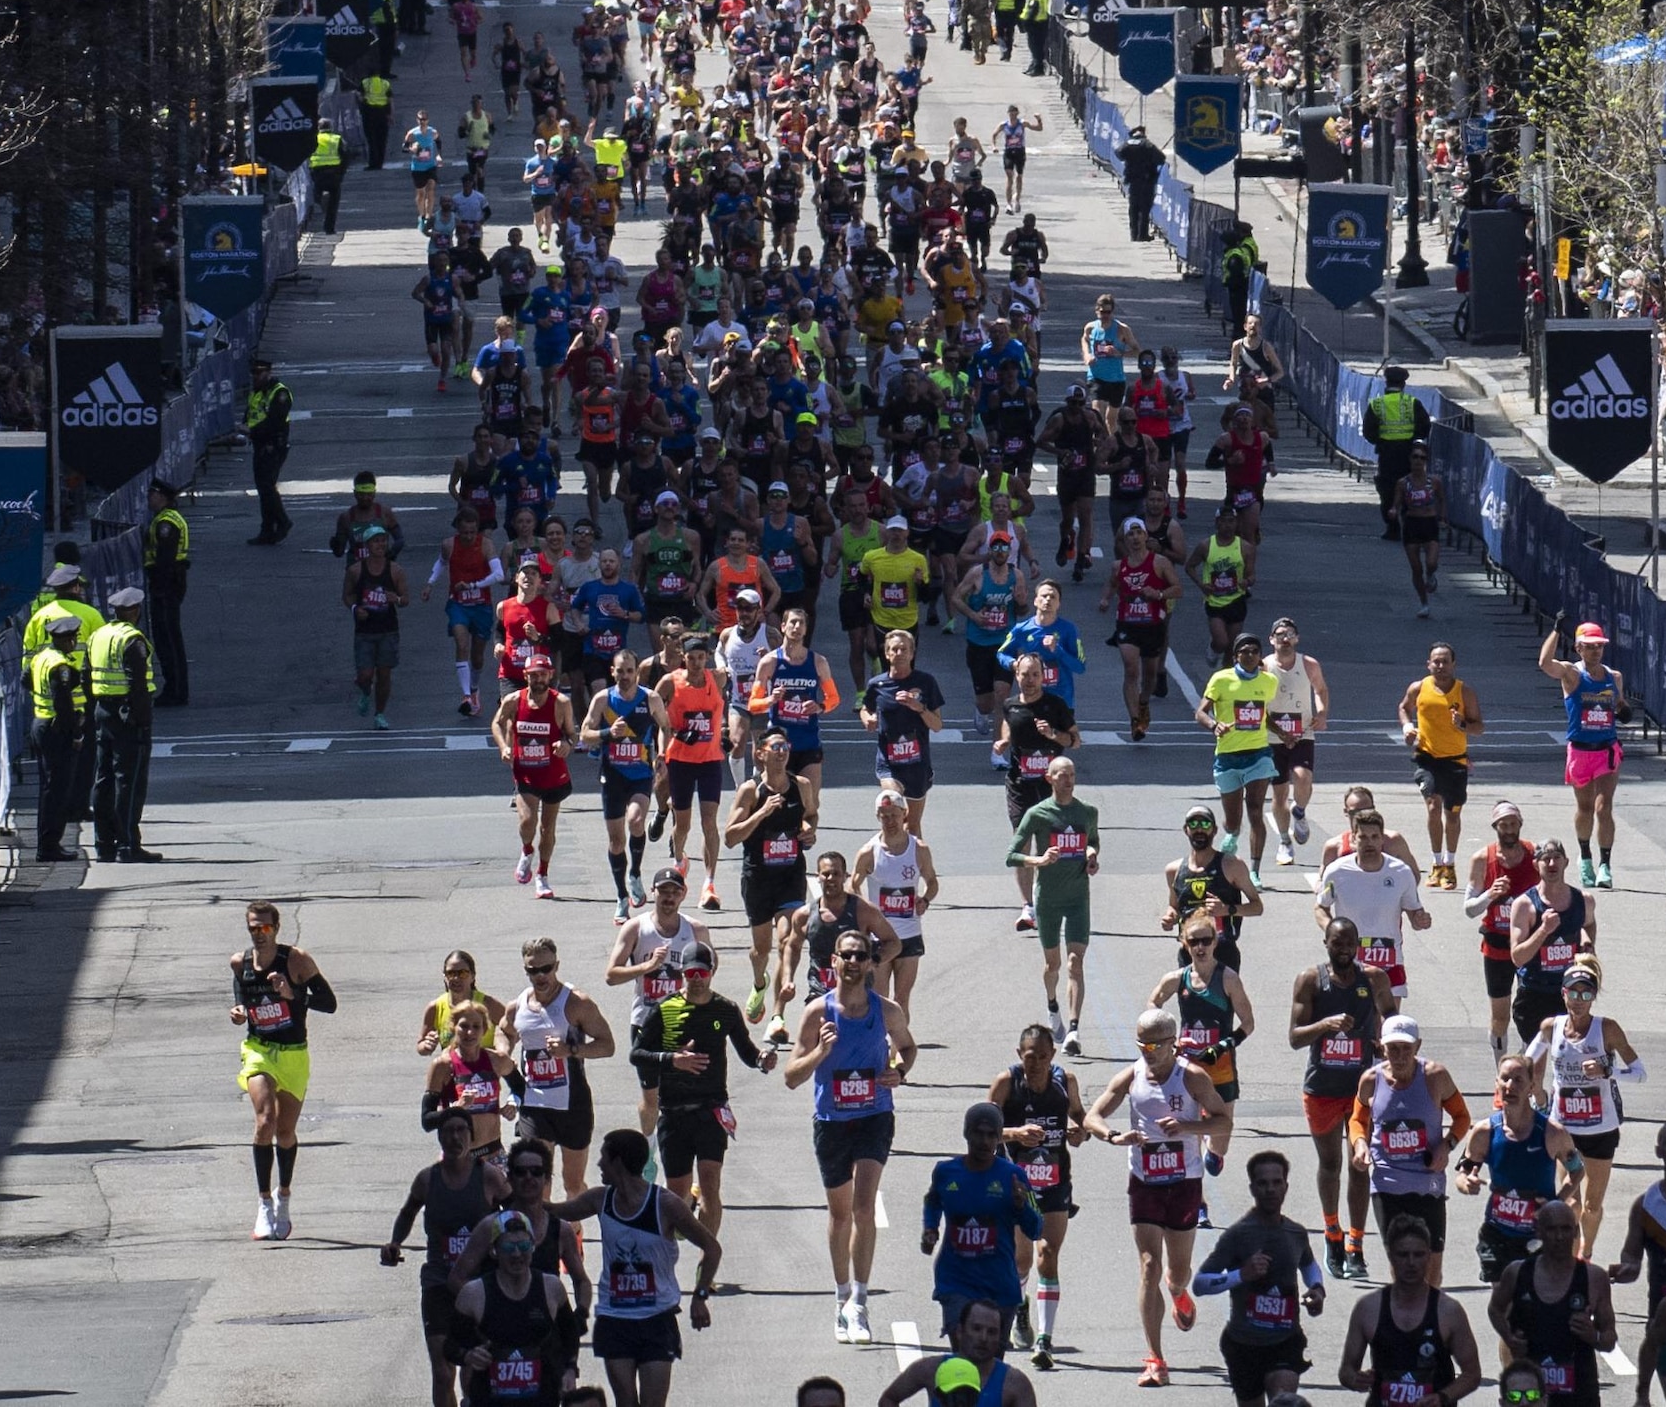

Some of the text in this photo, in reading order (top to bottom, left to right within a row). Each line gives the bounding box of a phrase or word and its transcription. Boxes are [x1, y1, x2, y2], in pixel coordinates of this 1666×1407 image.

[1093, 11, 1119, 23] adi
[259, 117, 313, 133] adidas
[1312, 238, 1382, 248] BOSTON MARATHON
[190, 250, 258, 259] BOSTON MARATHON
[1551, 394, 1648, 419] adidas
[61, 405, 158, 428] adidas
[774, 678, 818, 687] ATHLETICO
[518, 725, 548, 733] CANADA
[1364, 947, 1390, 963] 2171
[651, 977, 676, 994] 1744
[1326, 1039, 1354, 1054] 2401
[532, 1059, 557, 1075] 4670
[841, 1079, 870, 1097] 6285
[1565, 1098, 1593, 1113] 6041
[957, 1226, 990, 1246] 7187
[618, 1274, 647, 1291] 3739
[497, 1361, 533, 1382] 3745
